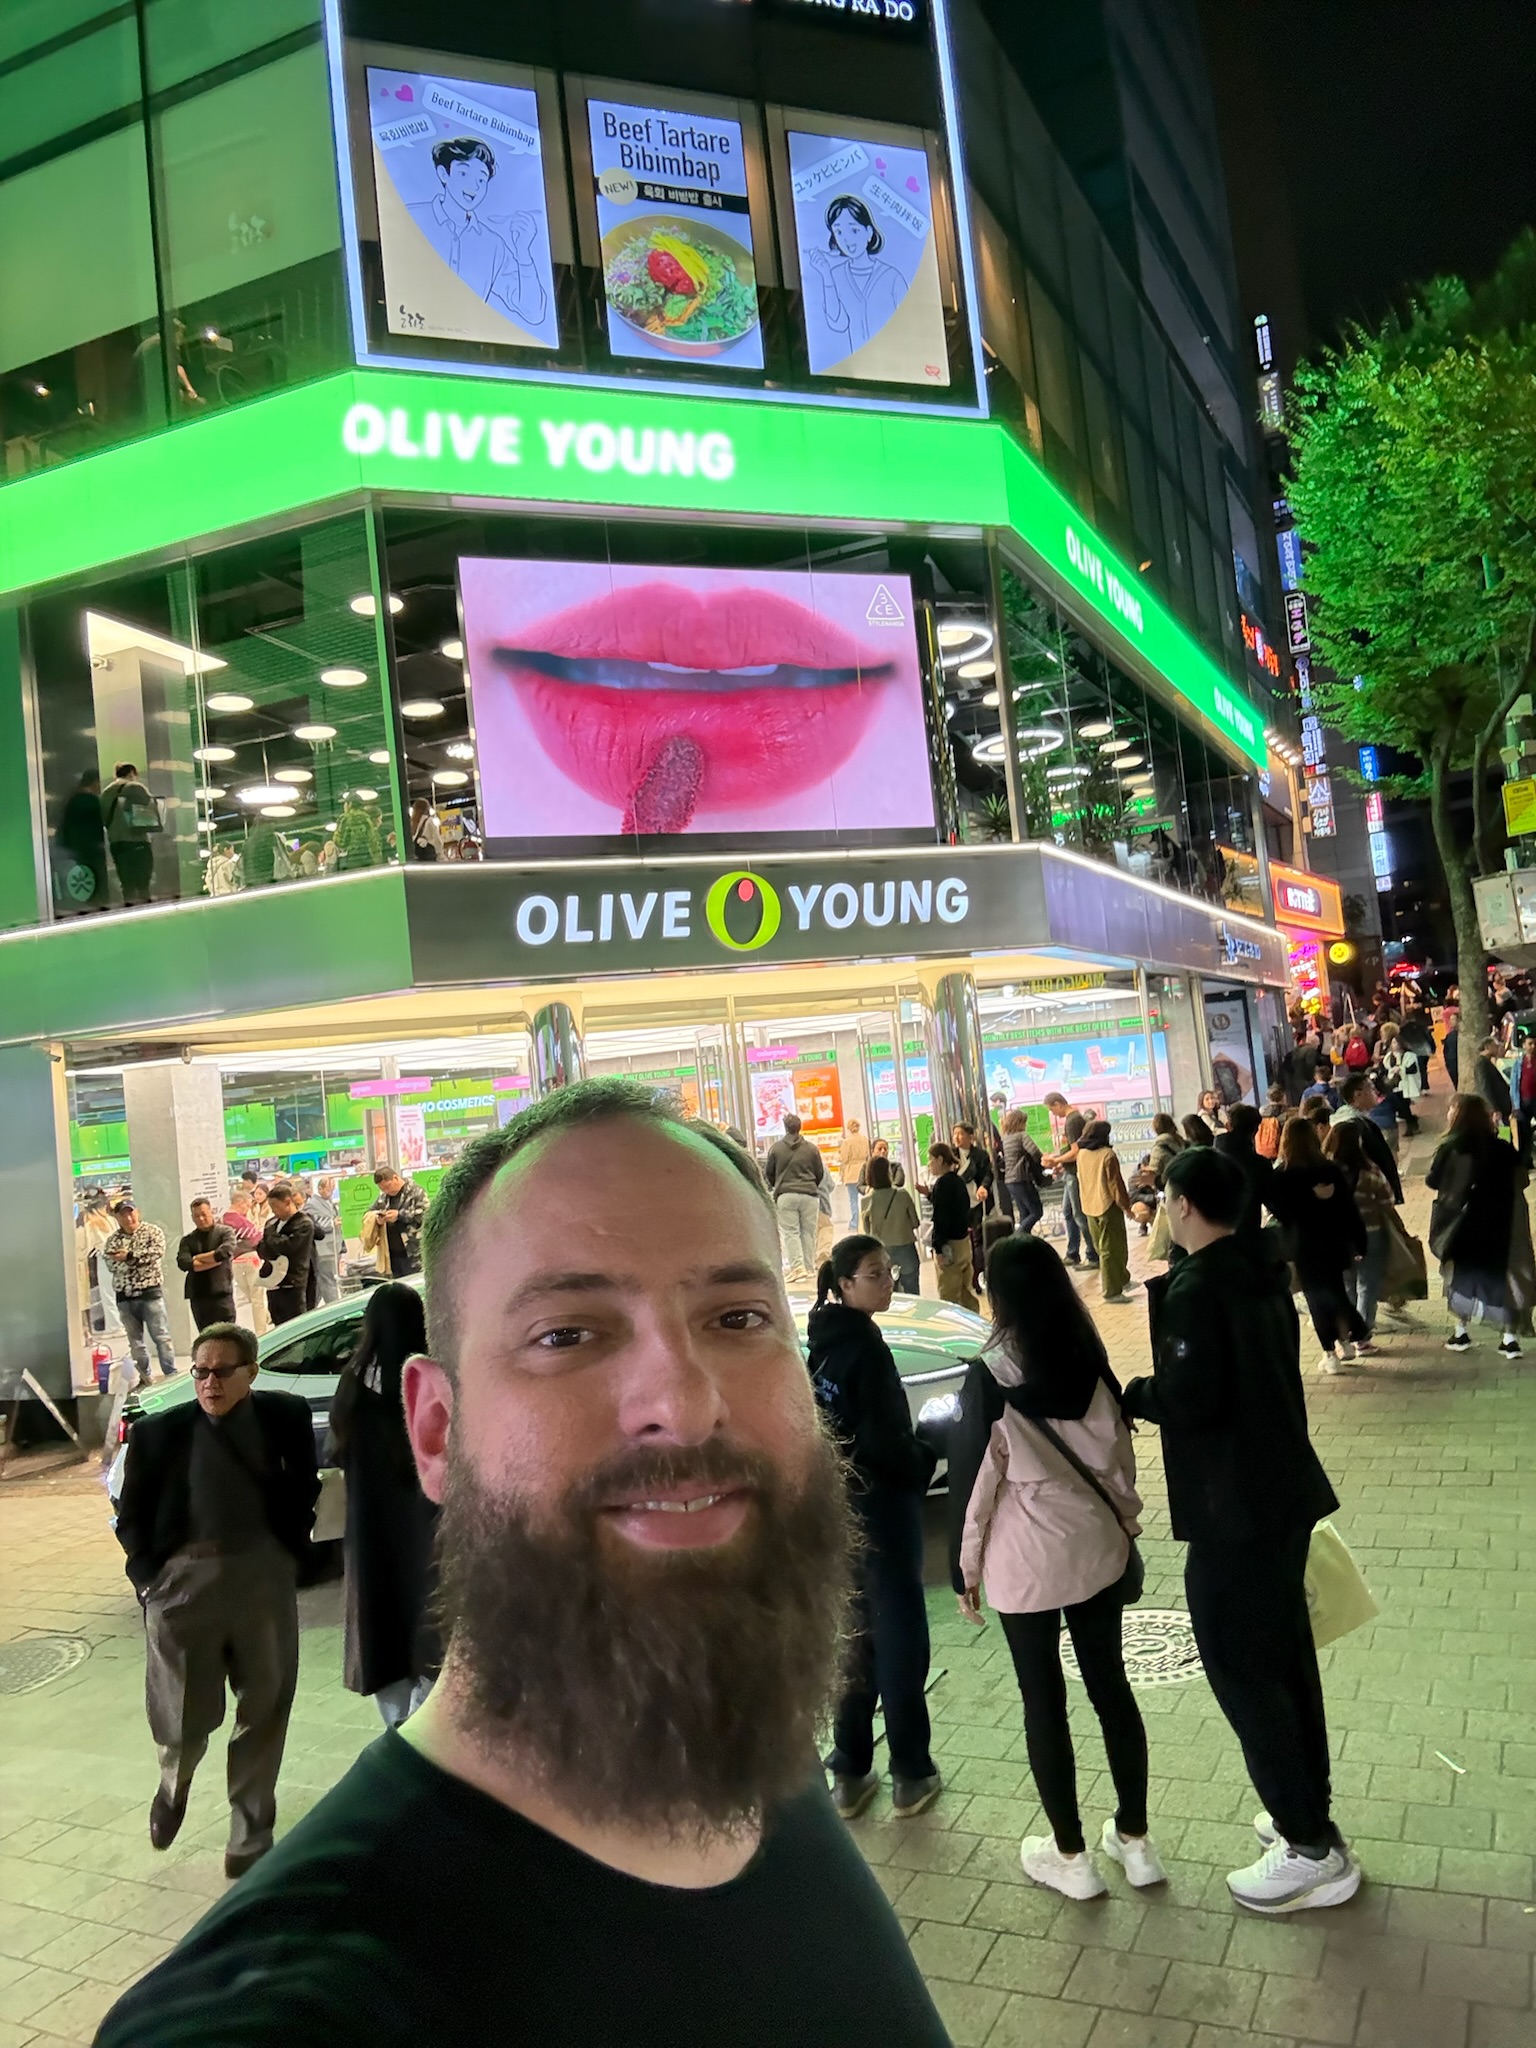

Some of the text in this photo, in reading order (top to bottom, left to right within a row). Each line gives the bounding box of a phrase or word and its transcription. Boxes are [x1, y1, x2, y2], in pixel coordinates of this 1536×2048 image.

[885, 0, 914, 21] DO
[431, 91, 535, 147] Beef Tartare Bibimbap
[603, 112, 730, 154] Beef Tartare
[620, 143, 721, 187] Bibimbap
[604, 181, 635, 194] NEW!
[643, 184, 666, 200] 육회
[668, 188, 699, 205] 비빔밥
[341, 403, 736, 482] OLIVE YOUNG
[1065, 525, 1144, 635] OLIVE YOUNG
[875, 605, 894, 615] CE
[880, 593, 888, 605] 3
[516, 877, 969, 946] OLIVE YOUNG
[436, 1095, 496, 1111] COSMETICS
